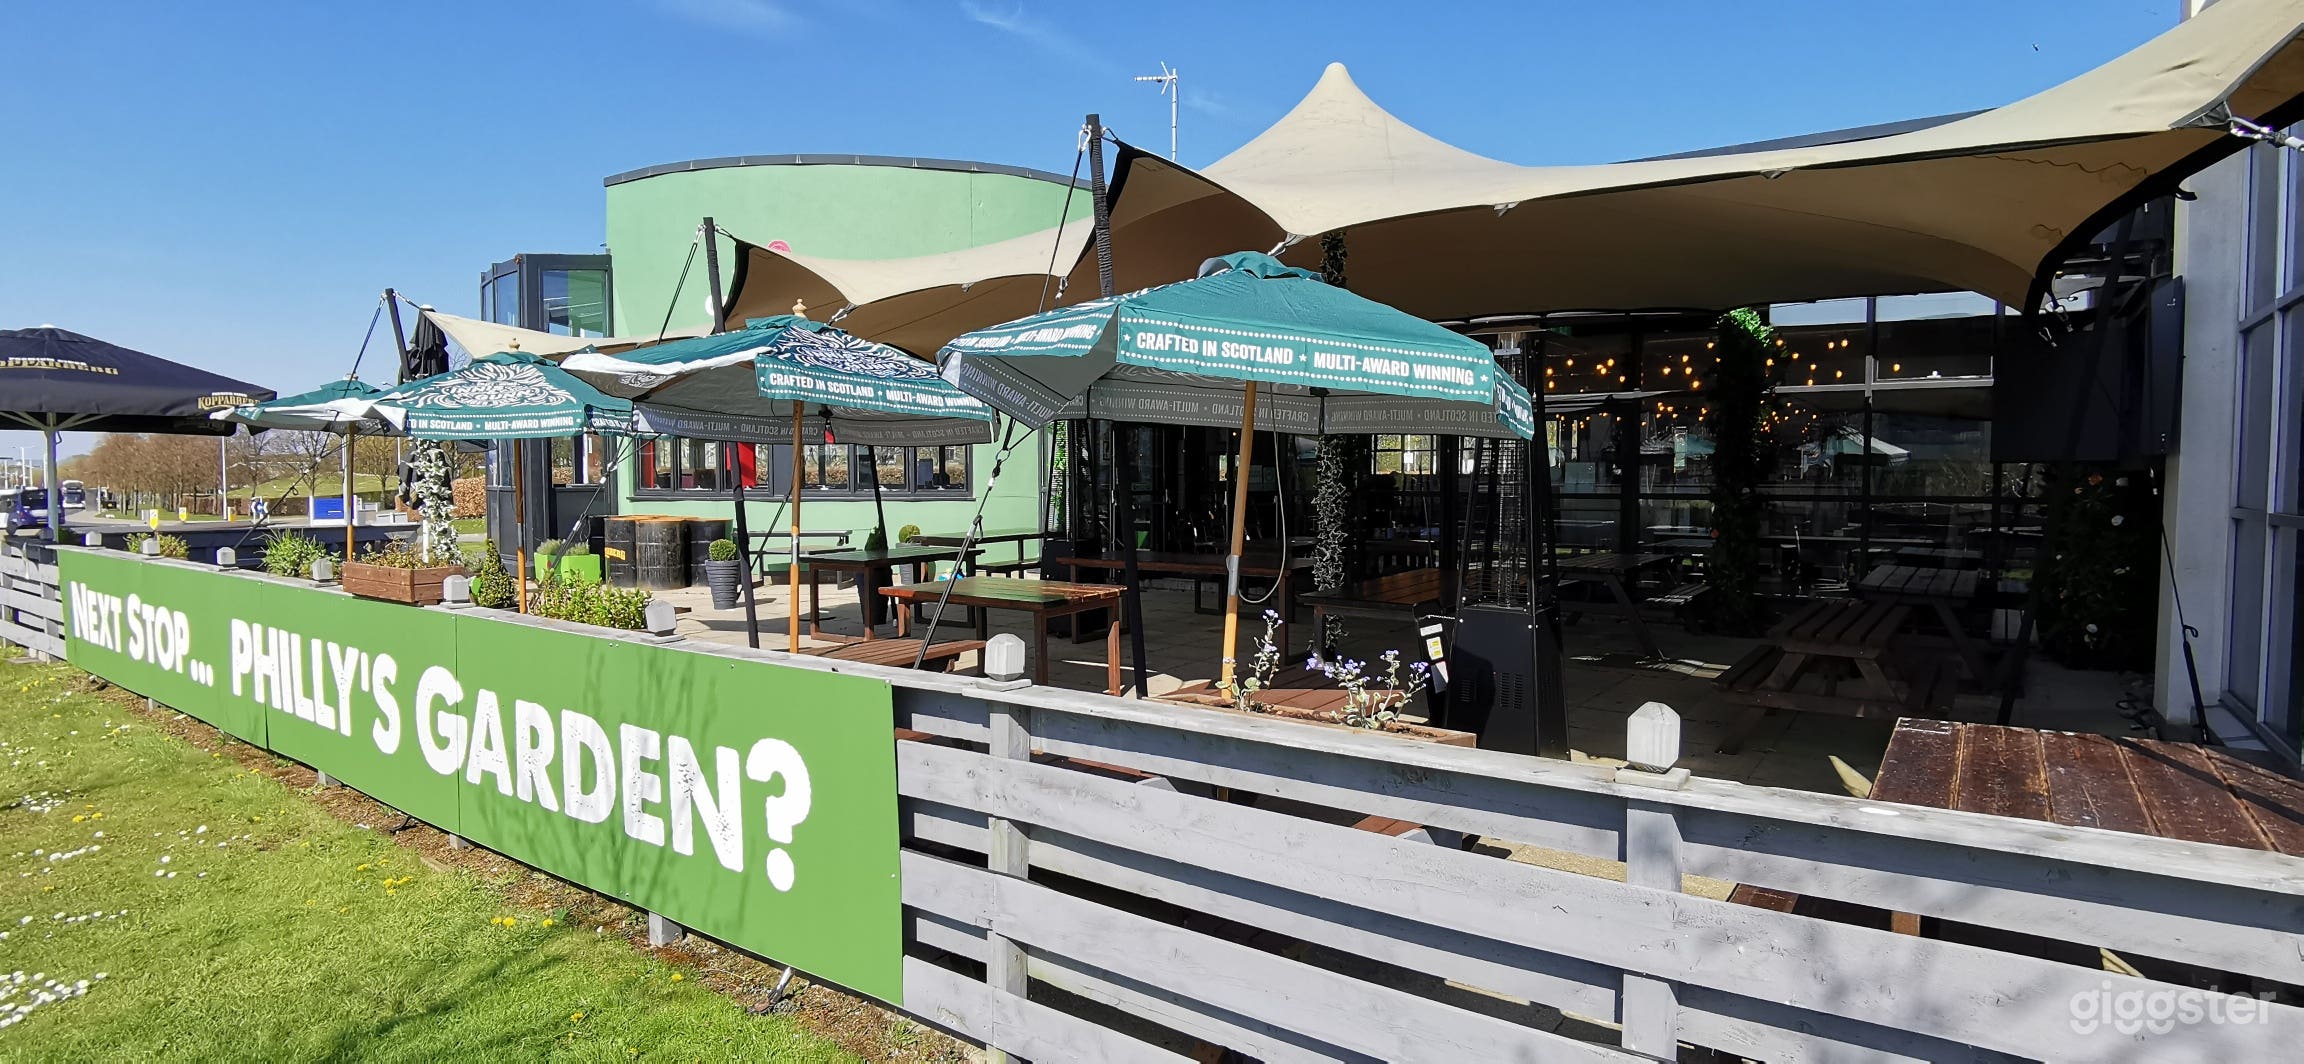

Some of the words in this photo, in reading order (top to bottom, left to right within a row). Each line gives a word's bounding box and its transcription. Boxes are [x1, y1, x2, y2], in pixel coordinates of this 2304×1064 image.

[1137, 332, 1198, 354] CRAFTED
[1202, 340, 1217, 357] IN
[1221, 341, 1293, 365] SCOTLAND
[1313, 352, 1410, 377] MULTI-AWARD
[1413, 363, 1474, 386] WINNING
[769, 372, 813, 389] CRAFTED
[815, 378, 826, 390] IN
[828, 380, 874, 398] SCOTLAND
[886, 390, 944, 407] MULTI-AWARD
[944, 394, 983, 408] WINNING
[430, 419, 473, 431] SCOTLAND
[485, 418, 538, 431] MULTI-AWARD
[540, 416, 573, 428] WINNING
[70, 580, 122, 654] NEXT
[126, 593, 215, 688] STOP...
[230, 618, 401, 755] PHILLY'S
[415, 665, 812, 892] GARDEN?
